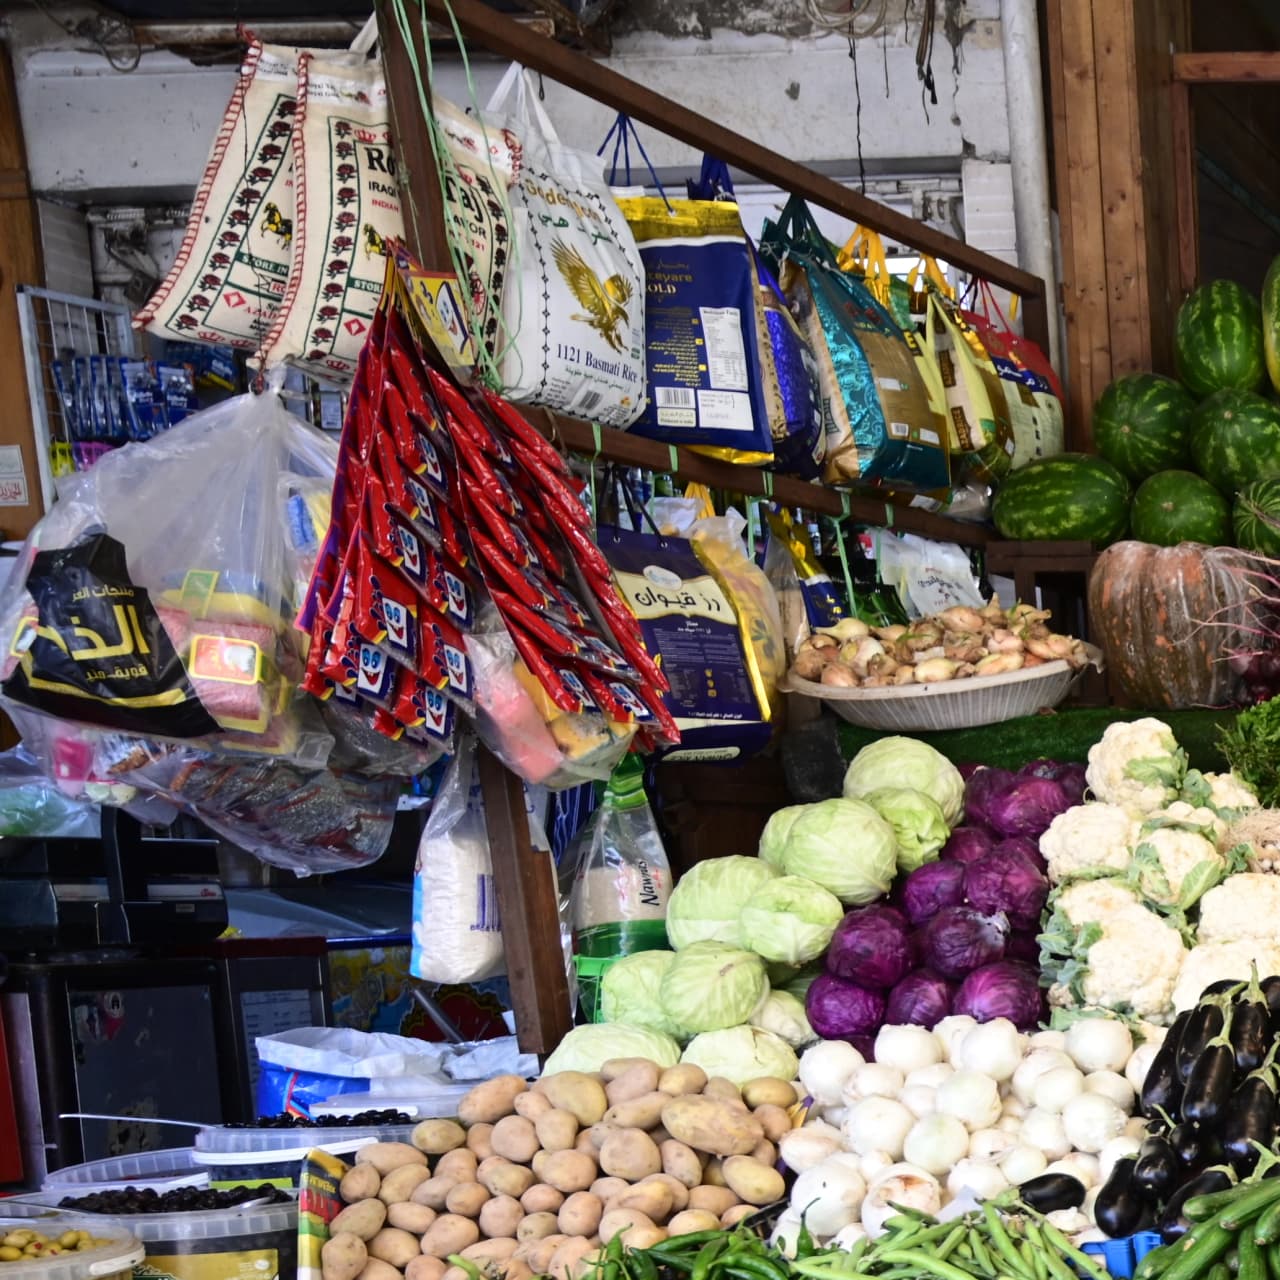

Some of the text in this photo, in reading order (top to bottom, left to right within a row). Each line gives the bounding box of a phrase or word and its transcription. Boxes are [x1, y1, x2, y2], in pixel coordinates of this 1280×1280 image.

[364, 146, 396, 177] Ro
[647, 283, 677, 294] OLD
[557, 343, 638, 384] 1121 Basmati Rice
[91, 583, 134, 598] منتجات
[634, 586, 720, 612] رز قيوان
